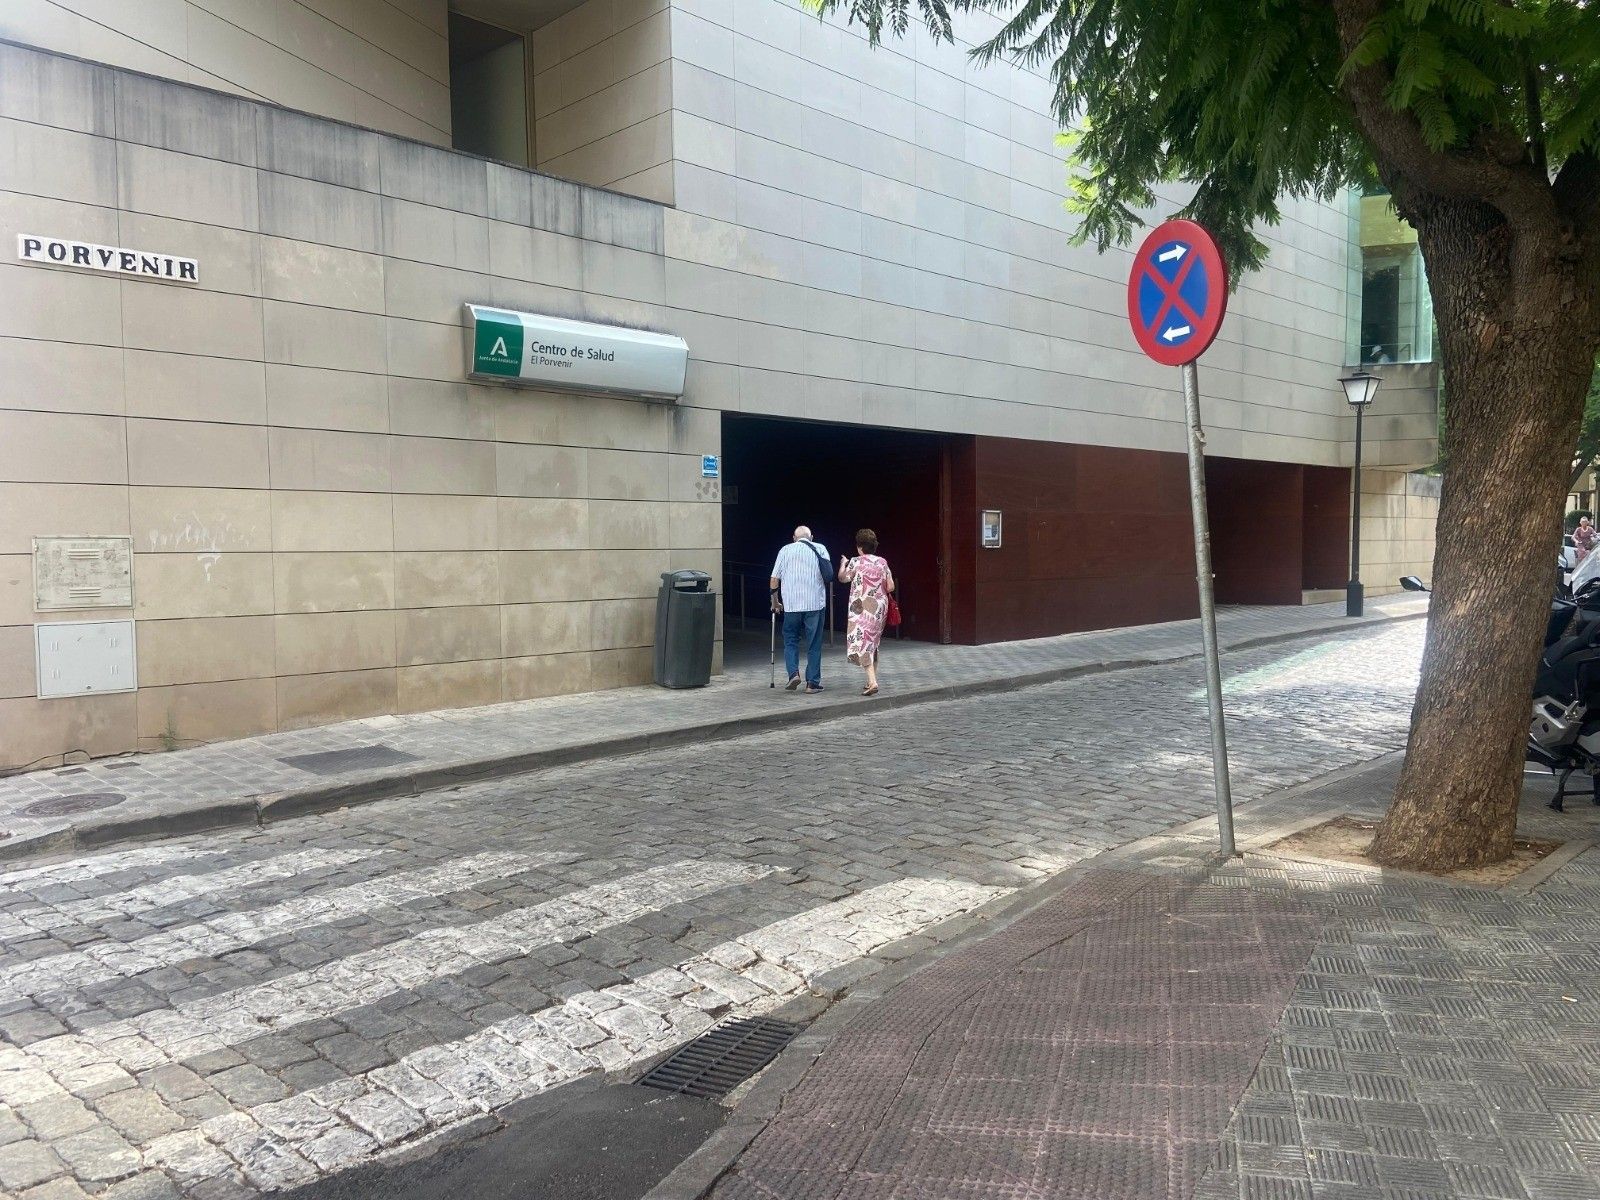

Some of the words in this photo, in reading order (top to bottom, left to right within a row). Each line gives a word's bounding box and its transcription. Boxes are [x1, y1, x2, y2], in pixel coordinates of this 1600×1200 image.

[24, 239, 196, 280] PORVENIR
[531, 341, 567, 356] Centro
[570, 346, 584, 358] de
[587, 348, 615, 362] Salud
[531, 355, 538, 364] El
[540, 357, 573, 368] Porvenir
